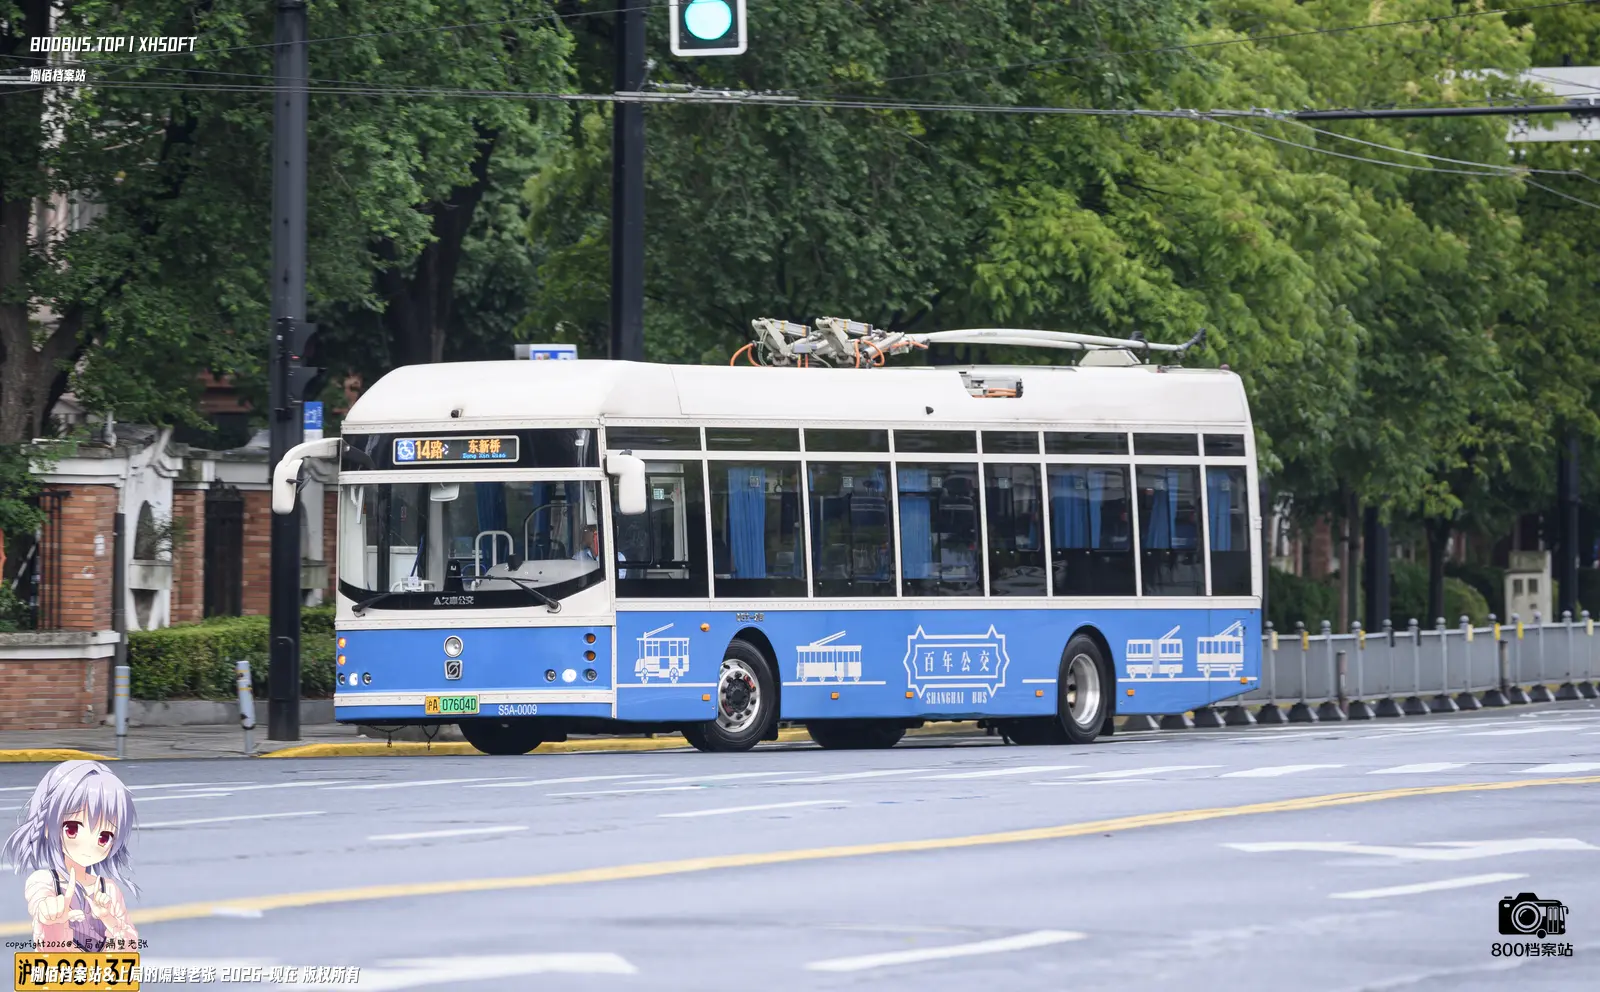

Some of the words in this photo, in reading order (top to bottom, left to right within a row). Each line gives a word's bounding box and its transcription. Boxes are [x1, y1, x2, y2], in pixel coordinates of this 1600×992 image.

[468, 439, 501, 453] 东新桥
[924, 650, 990, 673] 百年公交
[926, 691, 964, 704] SHANGHAI
[972, 691, 988, 704] BUS
[498, 704, 538, 716] S5A-0009
